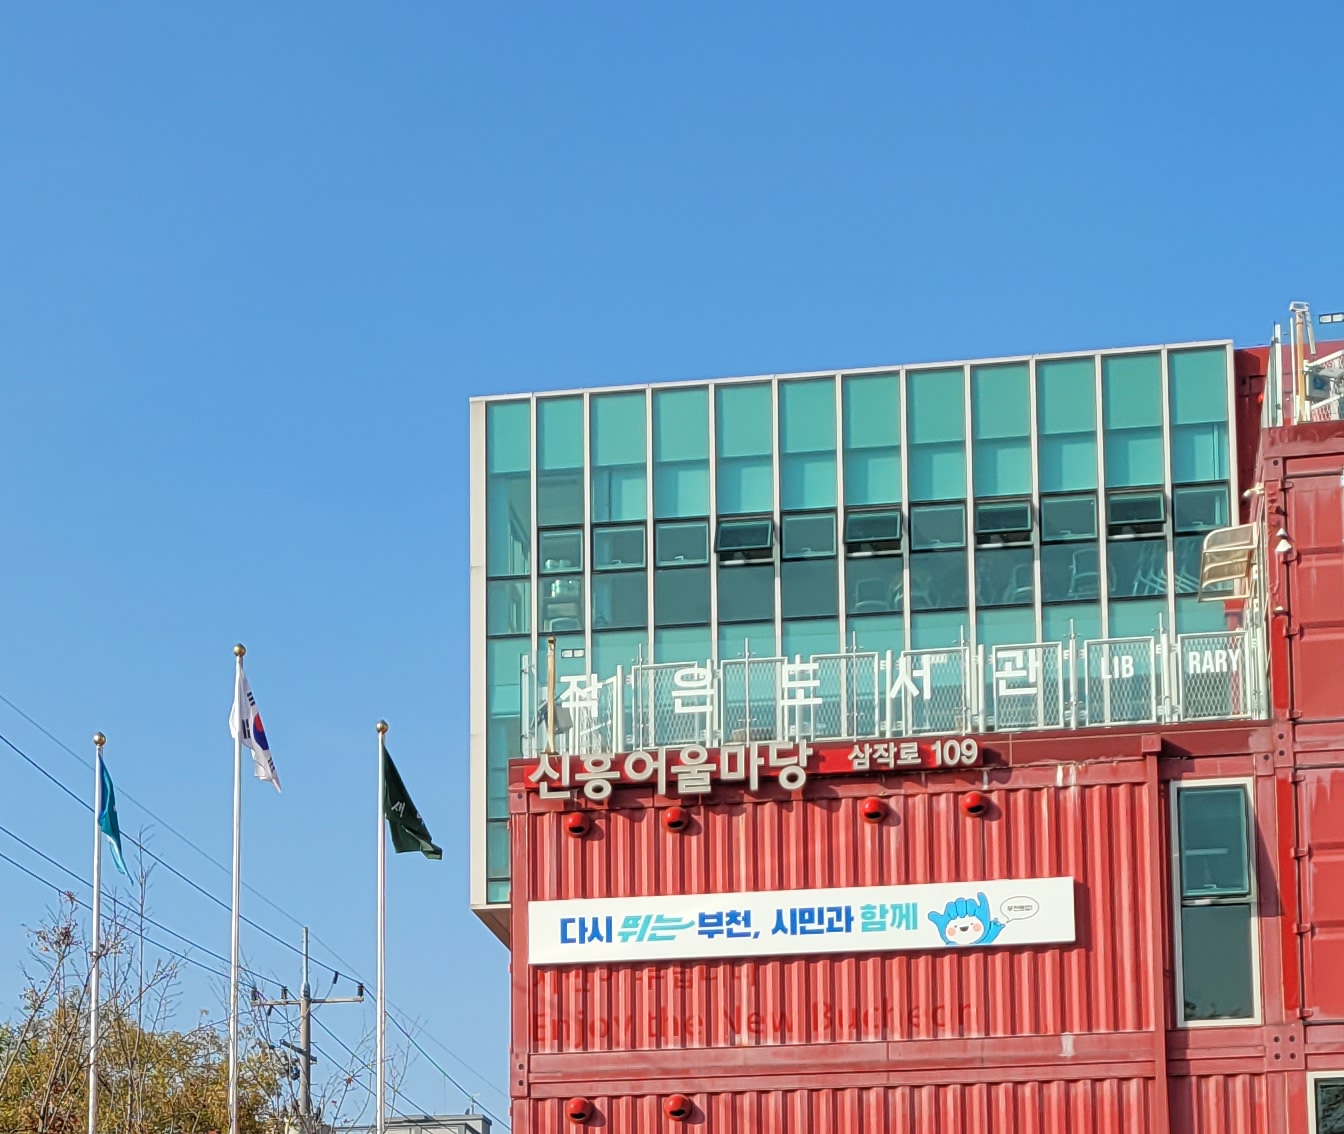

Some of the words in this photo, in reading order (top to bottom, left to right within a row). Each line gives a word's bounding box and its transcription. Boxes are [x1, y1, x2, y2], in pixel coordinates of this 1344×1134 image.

[1101, 655, 1135, 680] LIB
[1188, 649, 1241, 674] RARY
[528, 739, 813, 801] 신흥어울마당
[847, 741, 922, 771] 삼작로
[931, 738, 979, 768] 109
[560, 915, 613, 945] 다시
[617, 913, 696, 943] 뛰는
[697, 909, 761, 940] 부천,
[771, 905, 854, 937] 시민과
[859, 902, 919, 932] 함께
